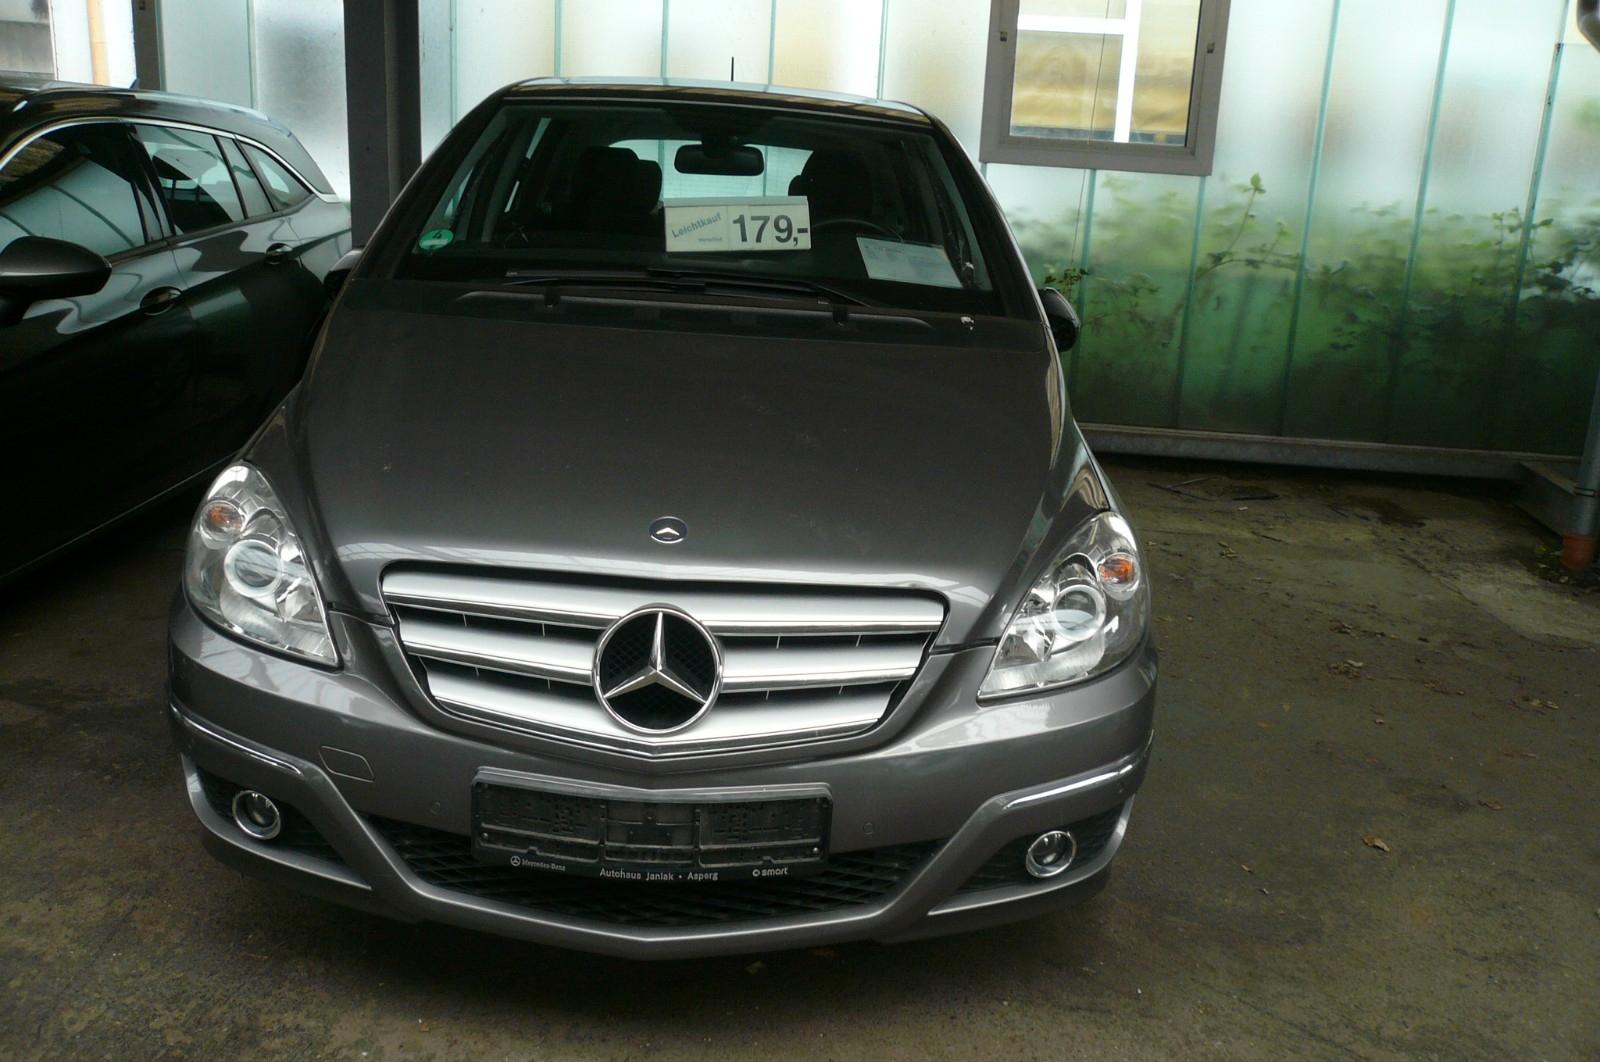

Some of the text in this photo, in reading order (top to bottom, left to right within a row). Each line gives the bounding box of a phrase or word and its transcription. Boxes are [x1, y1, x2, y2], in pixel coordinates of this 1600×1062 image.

[671, 212, 722, 239] Leichtkauf
[732, 213, 809, 247] 179,-
[599, 867, 642, 881] Autohaus
[761, 867, 788, 878] smart
